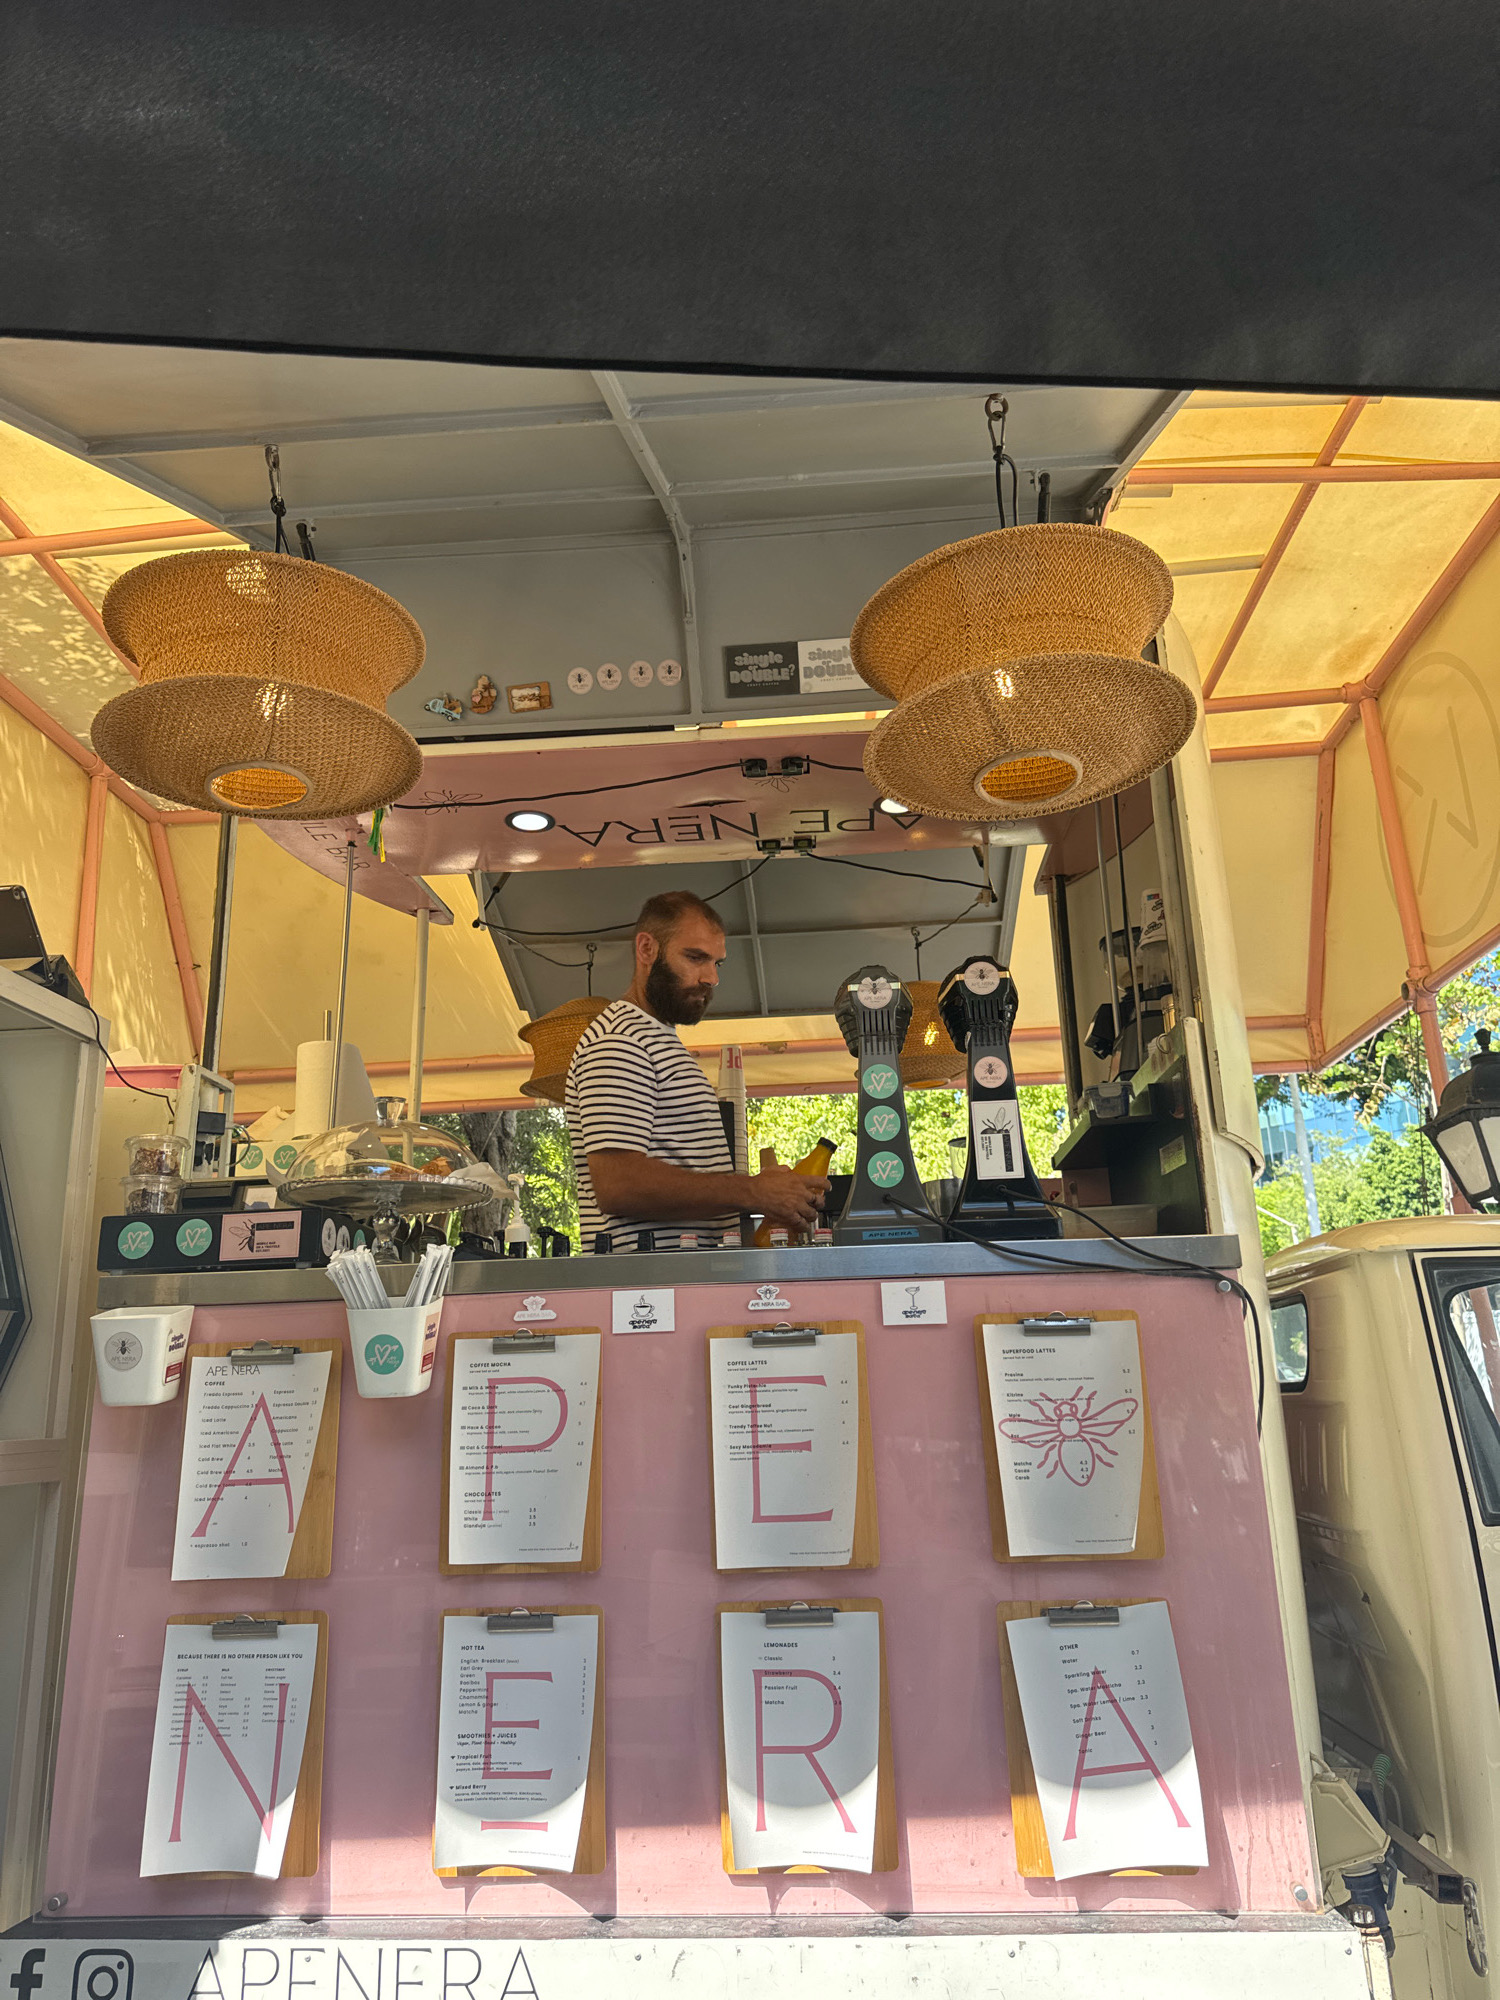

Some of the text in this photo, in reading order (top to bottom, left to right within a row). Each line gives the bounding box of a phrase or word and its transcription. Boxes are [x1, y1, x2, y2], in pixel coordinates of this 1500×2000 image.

[729, 664, 795, 684] DOUBLE?
[734, 651, 783, 668] single
[803, 663, 857, 679] DOUBL
[808, 646, 850, 662] singl
[558, 811, 760, 847] NERA
[206, 1365, 261, 1377] APE NERA
[190, 1392, 294, 1537] A
[482, 1376, 569, 1521] P
[748, 1375, 834, 1523] E
[1064, 1671, 1090, 1679] Sparkling
[168, 1681, 290, 1844] N
[752, 1669, 858, 1833] R
[1062, 1665, 1192, 1841] A
[187, 1946, 542, 2000] APENERA
